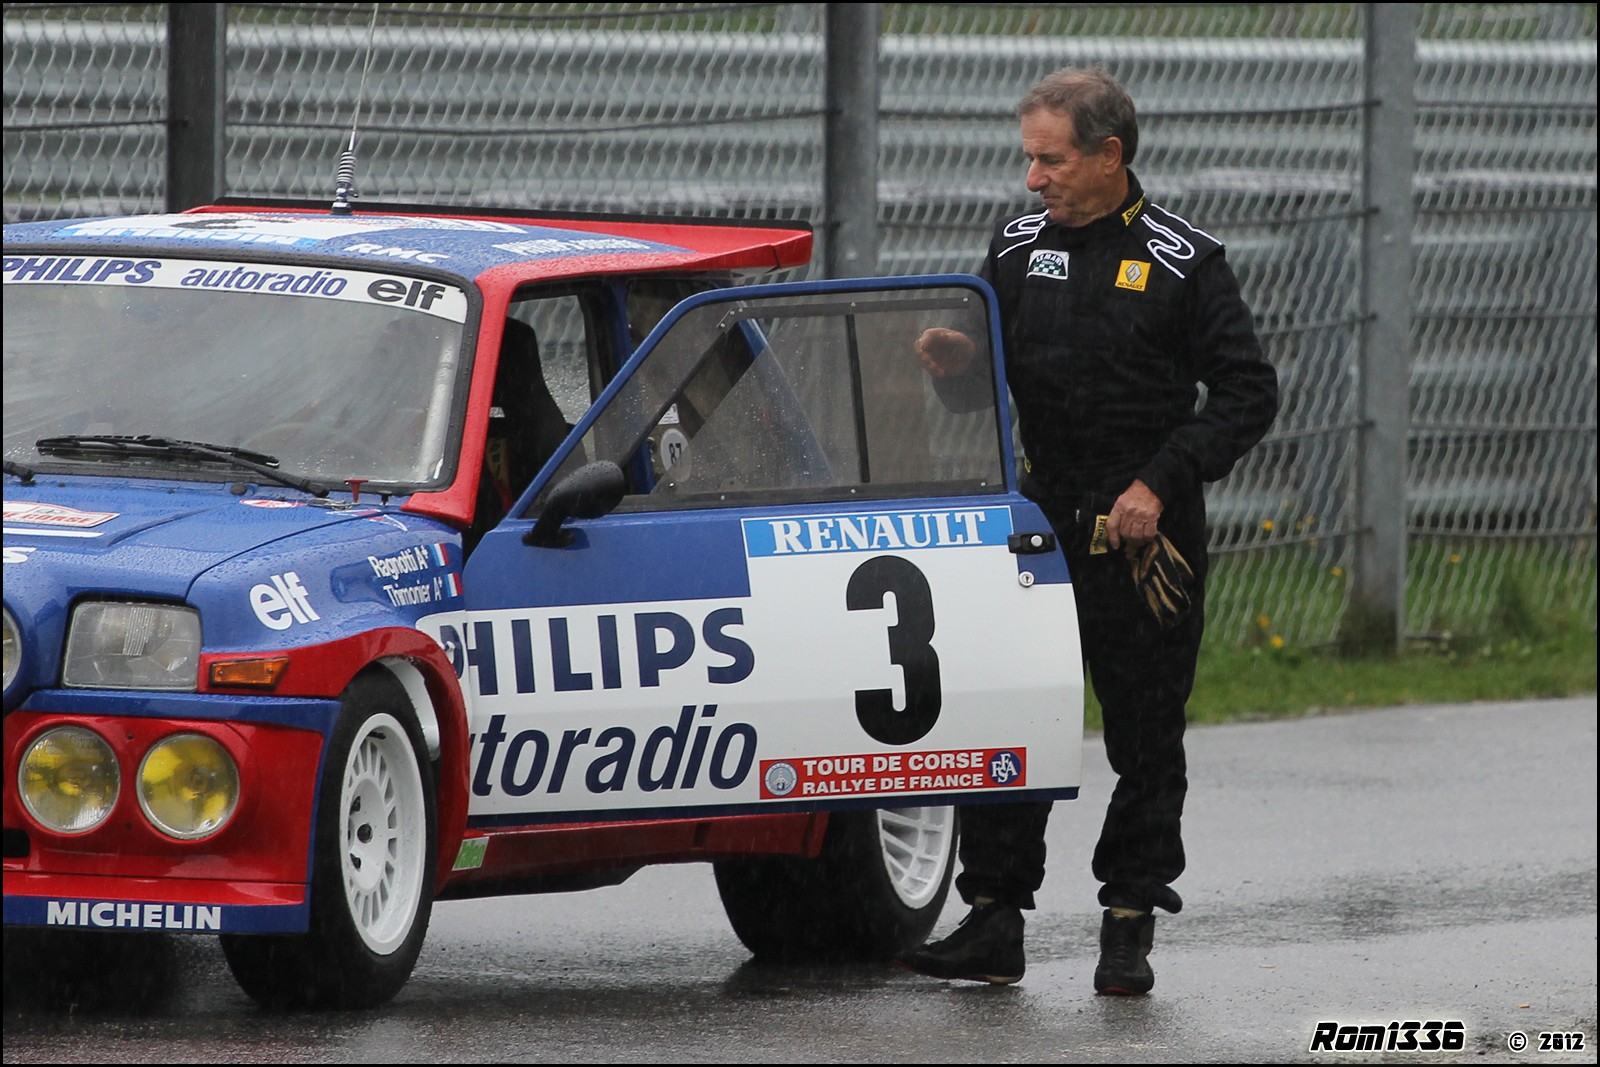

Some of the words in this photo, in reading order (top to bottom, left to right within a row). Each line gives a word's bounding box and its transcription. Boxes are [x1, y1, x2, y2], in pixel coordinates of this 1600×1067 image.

[343, 243, 451, 263] RMC
[3, 257, 162, 284] PHILIPS
[181, 265, 348, 297] autoradio
[367, 278, 447, 311] elf
[768, 511, 986, 555] RENAULT
[367, 548, 419, 580] Ragnotti
[249, 571, 321, 630] elf
[846, 555, 942, 746] 3
[803, 757, 866, 776] TOUR
[873, 755, 902, 773] DE
[908, 752, 984, 771] CORSE
[802, 777, 876, 795] RALLYE
[880, 776, 906, 791] DE
[909, 773, 984, 789] FRANCE
[46, 901, 222, 930] MICHELIN
